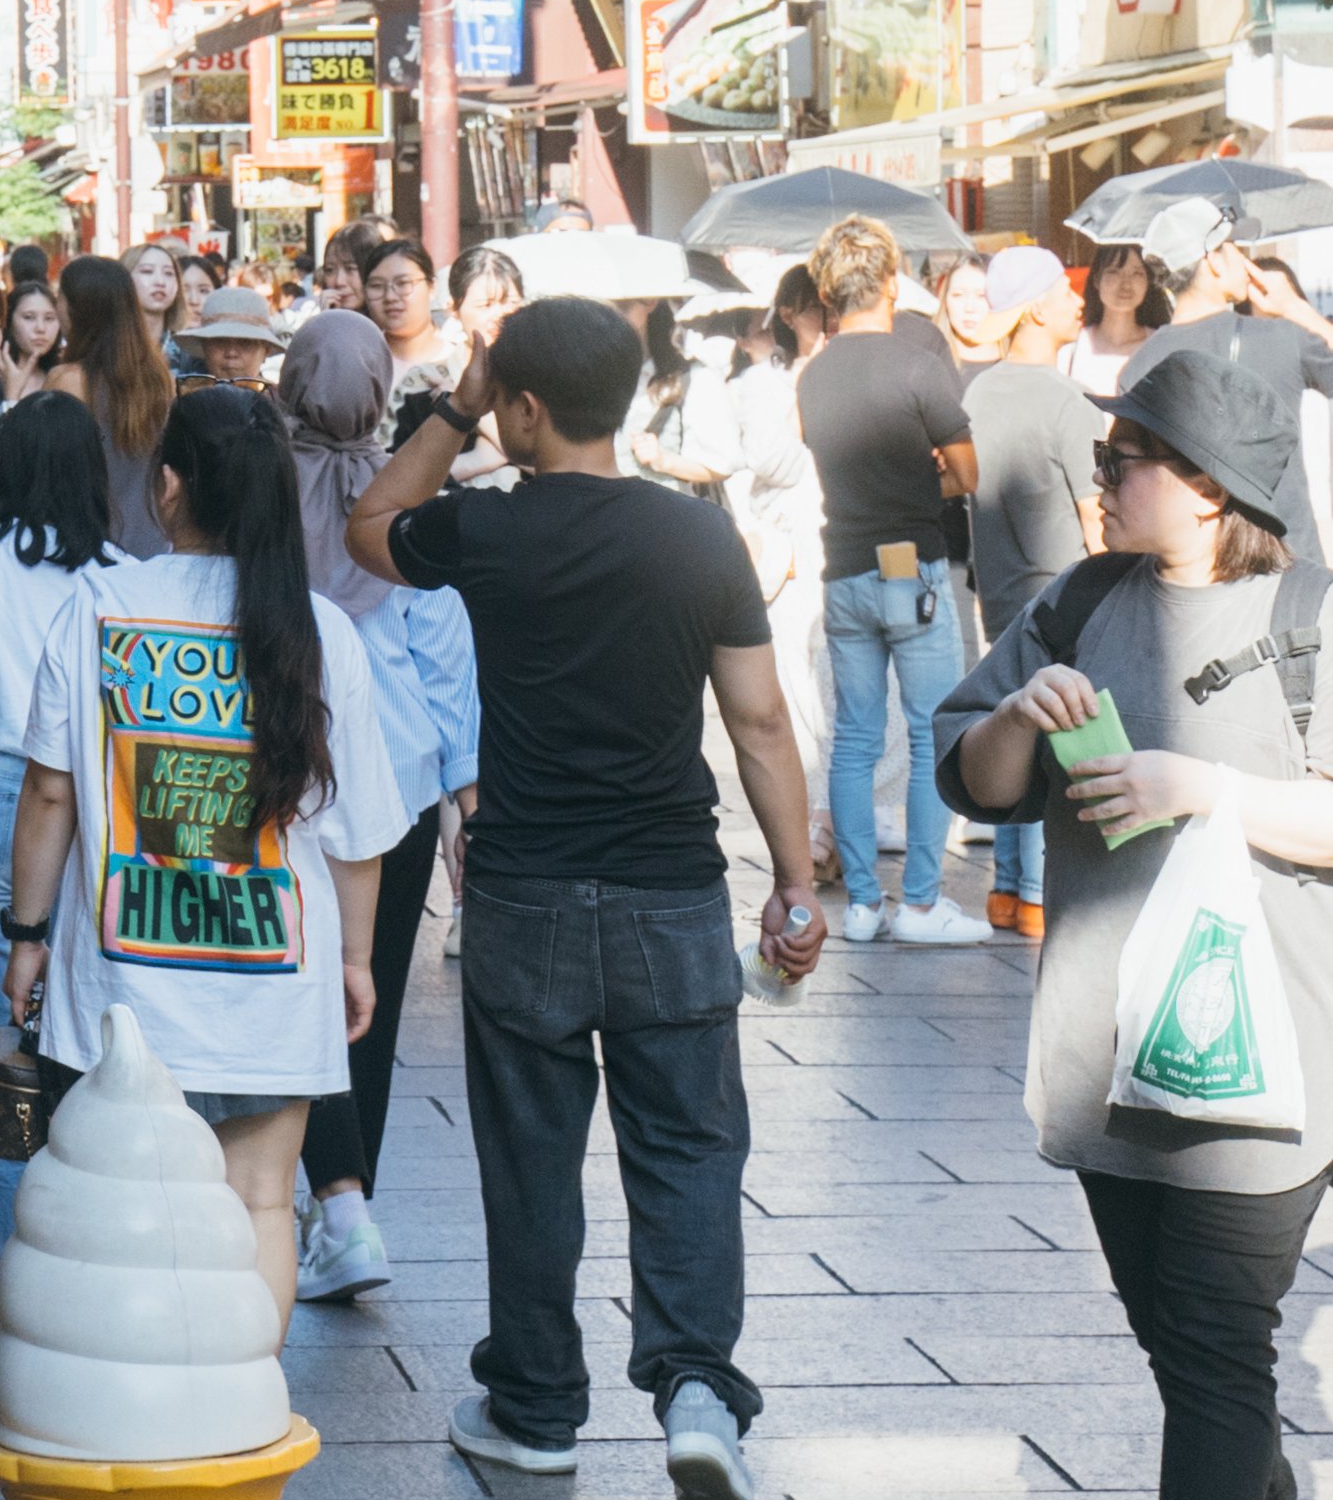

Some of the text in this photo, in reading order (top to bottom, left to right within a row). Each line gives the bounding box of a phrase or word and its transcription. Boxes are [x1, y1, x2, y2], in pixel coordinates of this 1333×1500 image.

[141, 637, 241, 684] YOU
[153, 749, 253, 793] KEEPS
[139, 783, 257, 829] LIFTING
[174, 822, 215, 859] ME
[119, 862, 286, 947] HIGHER
